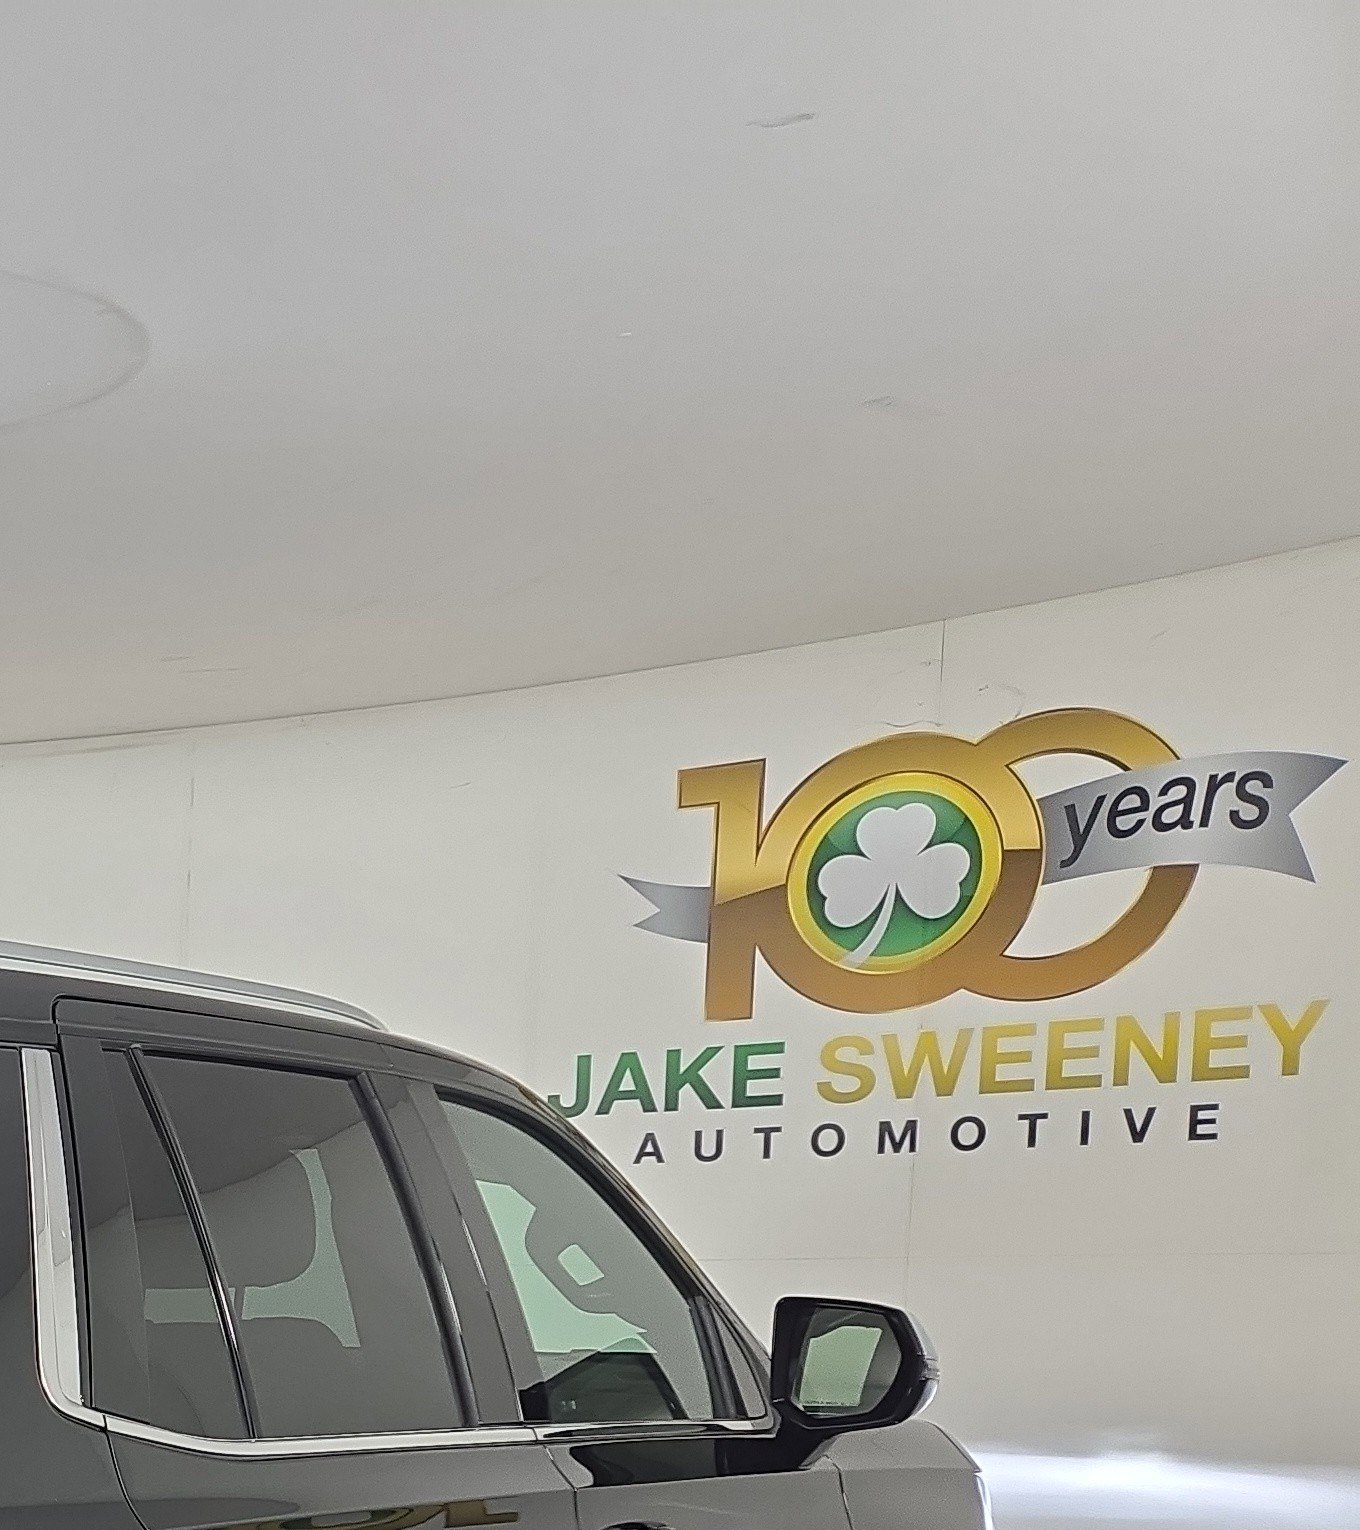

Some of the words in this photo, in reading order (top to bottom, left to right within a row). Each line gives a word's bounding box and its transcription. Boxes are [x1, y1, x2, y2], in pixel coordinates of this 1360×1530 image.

[678, 707, 1199, 1022] 100
[1060, 769, 1275, 868] years
[547, 1041, 786, 1118] JAKE
[816, 1000, 1331, 1105] SWEENEY
[633, 1103, 1221, 1165] AUTOMOTIVE
